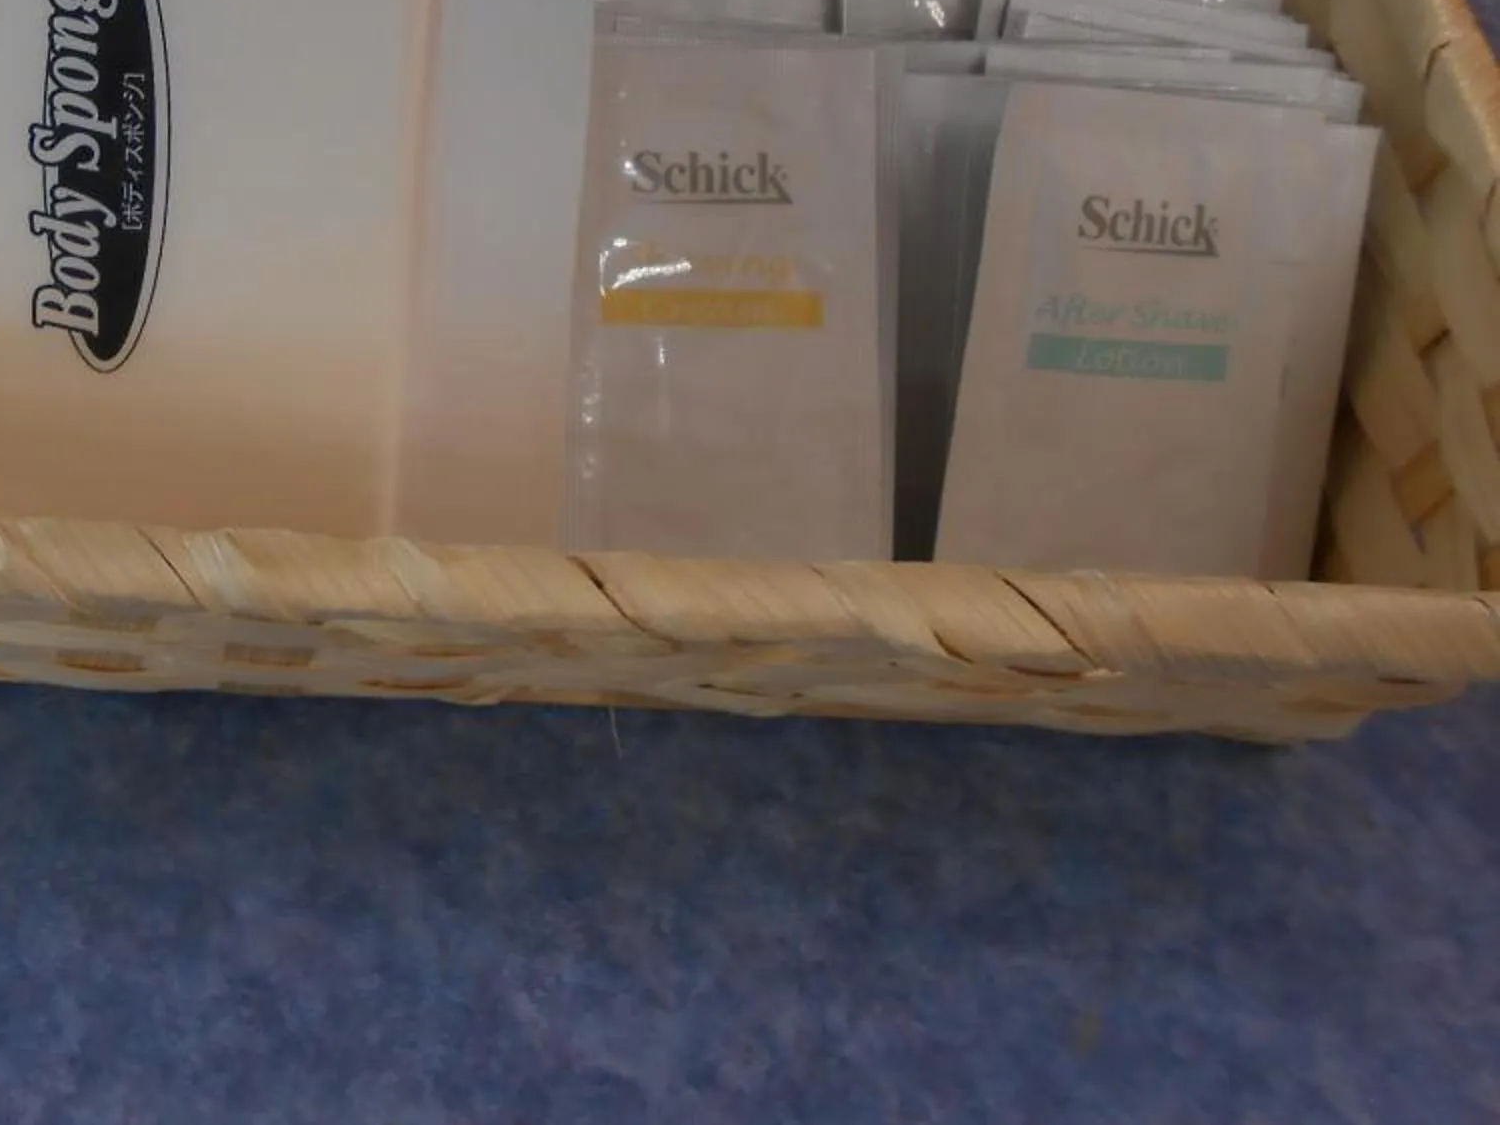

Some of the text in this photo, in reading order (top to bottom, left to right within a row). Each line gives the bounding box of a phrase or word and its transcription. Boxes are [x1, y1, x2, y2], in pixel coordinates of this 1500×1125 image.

[631, 150, 793, 204] Schick
[1077, 194, 1219, 258] Schick
[30, 186, 117, 335] Body
